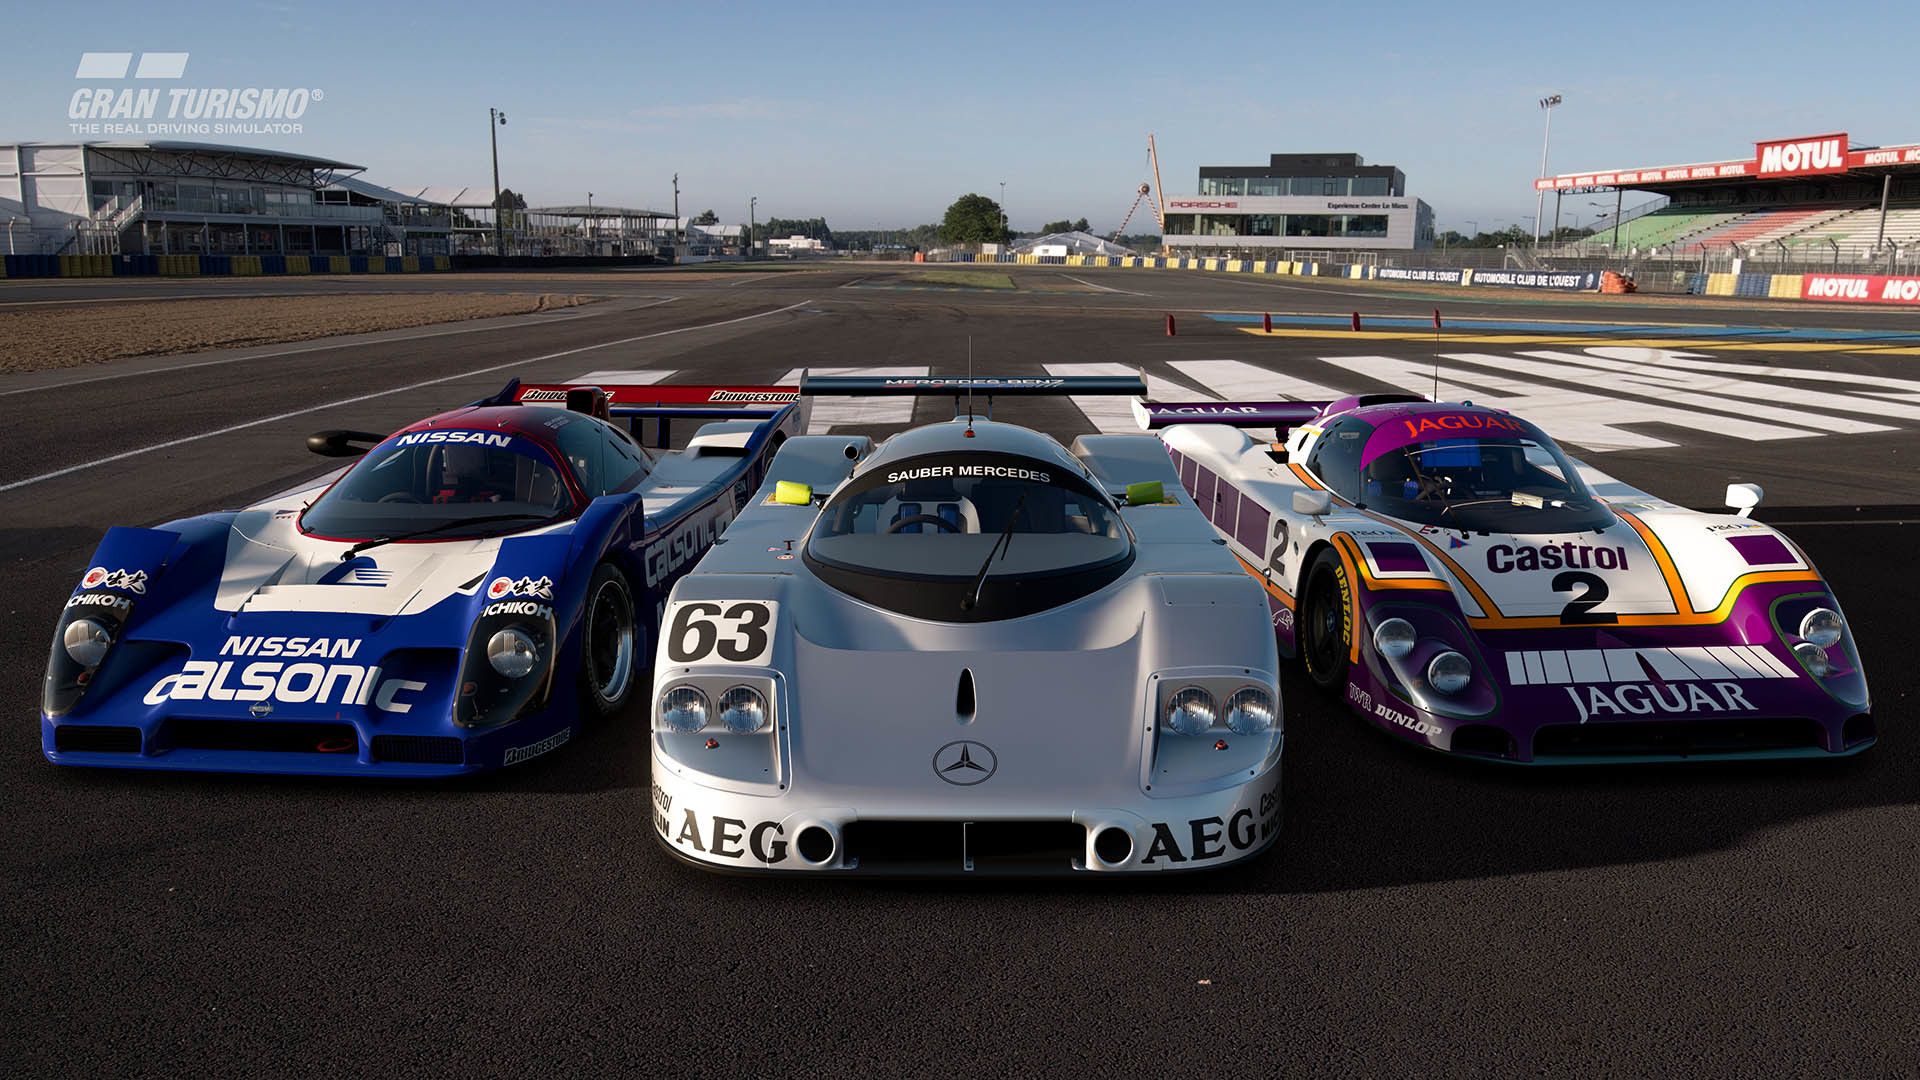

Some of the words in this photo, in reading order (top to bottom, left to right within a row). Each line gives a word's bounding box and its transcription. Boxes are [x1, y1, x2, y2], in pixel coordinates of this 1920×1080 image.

[1760, 140, 1843, 173] MOTUL
[1864, 151, 1899, 164] MOTUL
[1665, 169, 1688, 180] MOTUL
[1691, 167, 1716, 178] MOTUL
[1719, 164, 1745, 176] MOTUL
[1380, 269, 1411, 279] AUTOMOBILE
[1412, 271, 1427, 280] CLUB
[1427, 271, 1435, 280] DE
[1474, 273, 1516, 284] AUTOMOBILE
[1517, 274, 1535, 285] CLUB
[1537, 275, 1548, 286] DE
[1549, 275, 1581, 287] L'OUEST
[1807, 278, 1869, 298] MOTUL
[1403, 415, 1527, 438] JAGUAR
[396, 432, 513, 448] NISSAN
[887, 465, 954, 483] SAUBER
[959, 465, 1051, 483] MERCEDES
[1269, 518, 1289, 577] 2
[1486, 541, 1629, 574] Castrol
[1551, 571, 1619, 625] 2
[483, 601, 553, 620] ICHIKOH
[668, 602, 770, 662] 63
[219, 636, 362, 659] NISSAN
[1564, 682, 1759, 725] JAGUAR
[1375, 704, 1442, 737] DUNLOP
[676, 807, 788, 864] AEG
[1141, 807, 1257, 864] AEG
